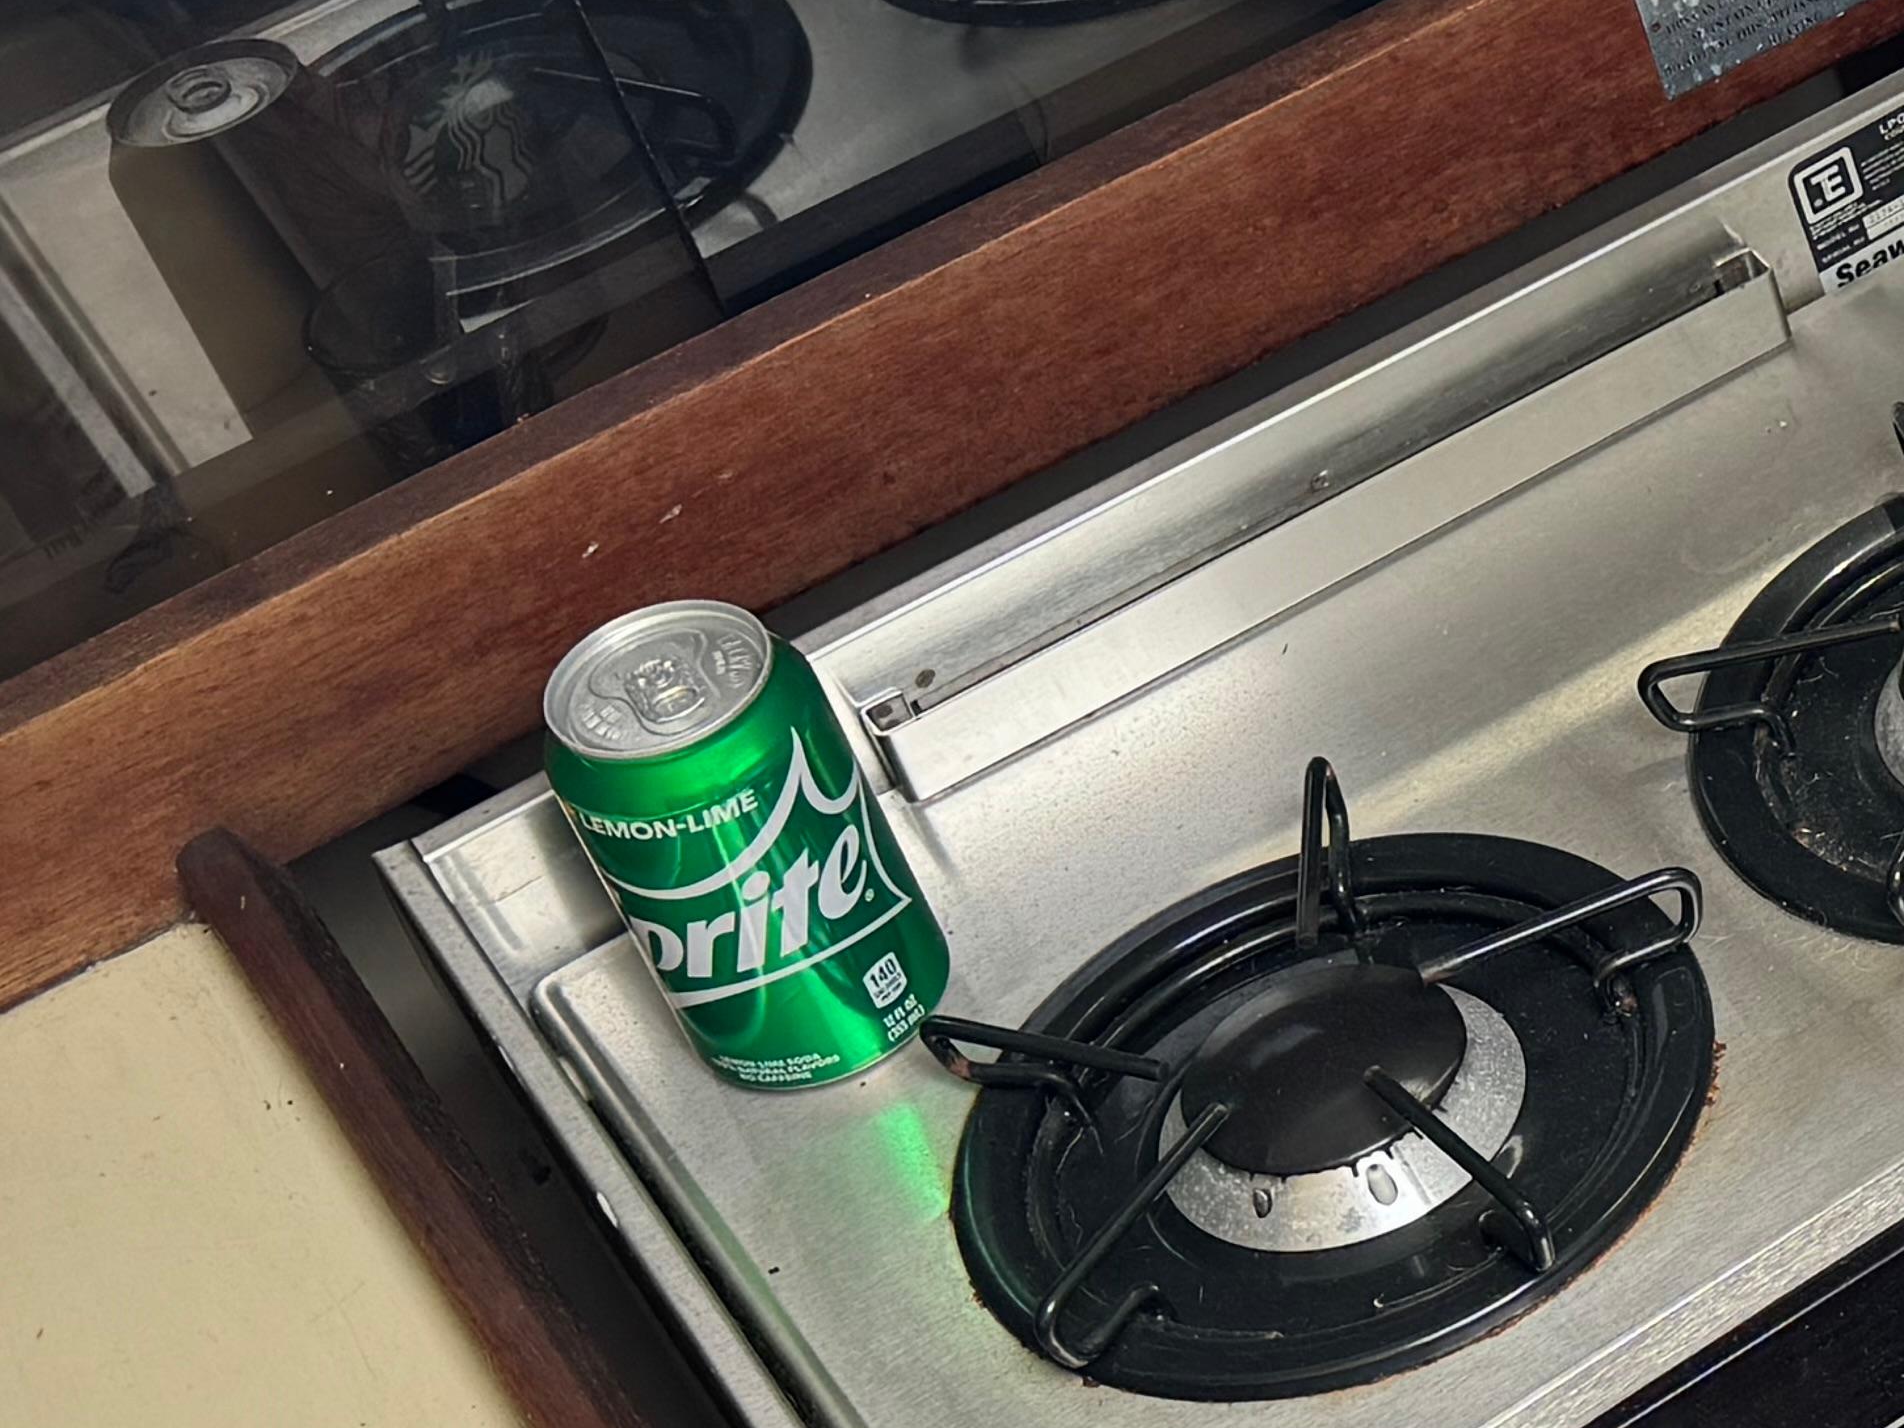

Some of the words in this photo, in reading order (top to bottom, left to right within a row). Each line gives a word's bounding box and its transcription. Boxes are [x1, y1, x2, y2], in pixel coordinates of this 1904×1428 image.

[579, 788, 759, 841] LEMON-LIME
[614, 824, 868, 978] prite
[870, 958, 897, 988] 140
